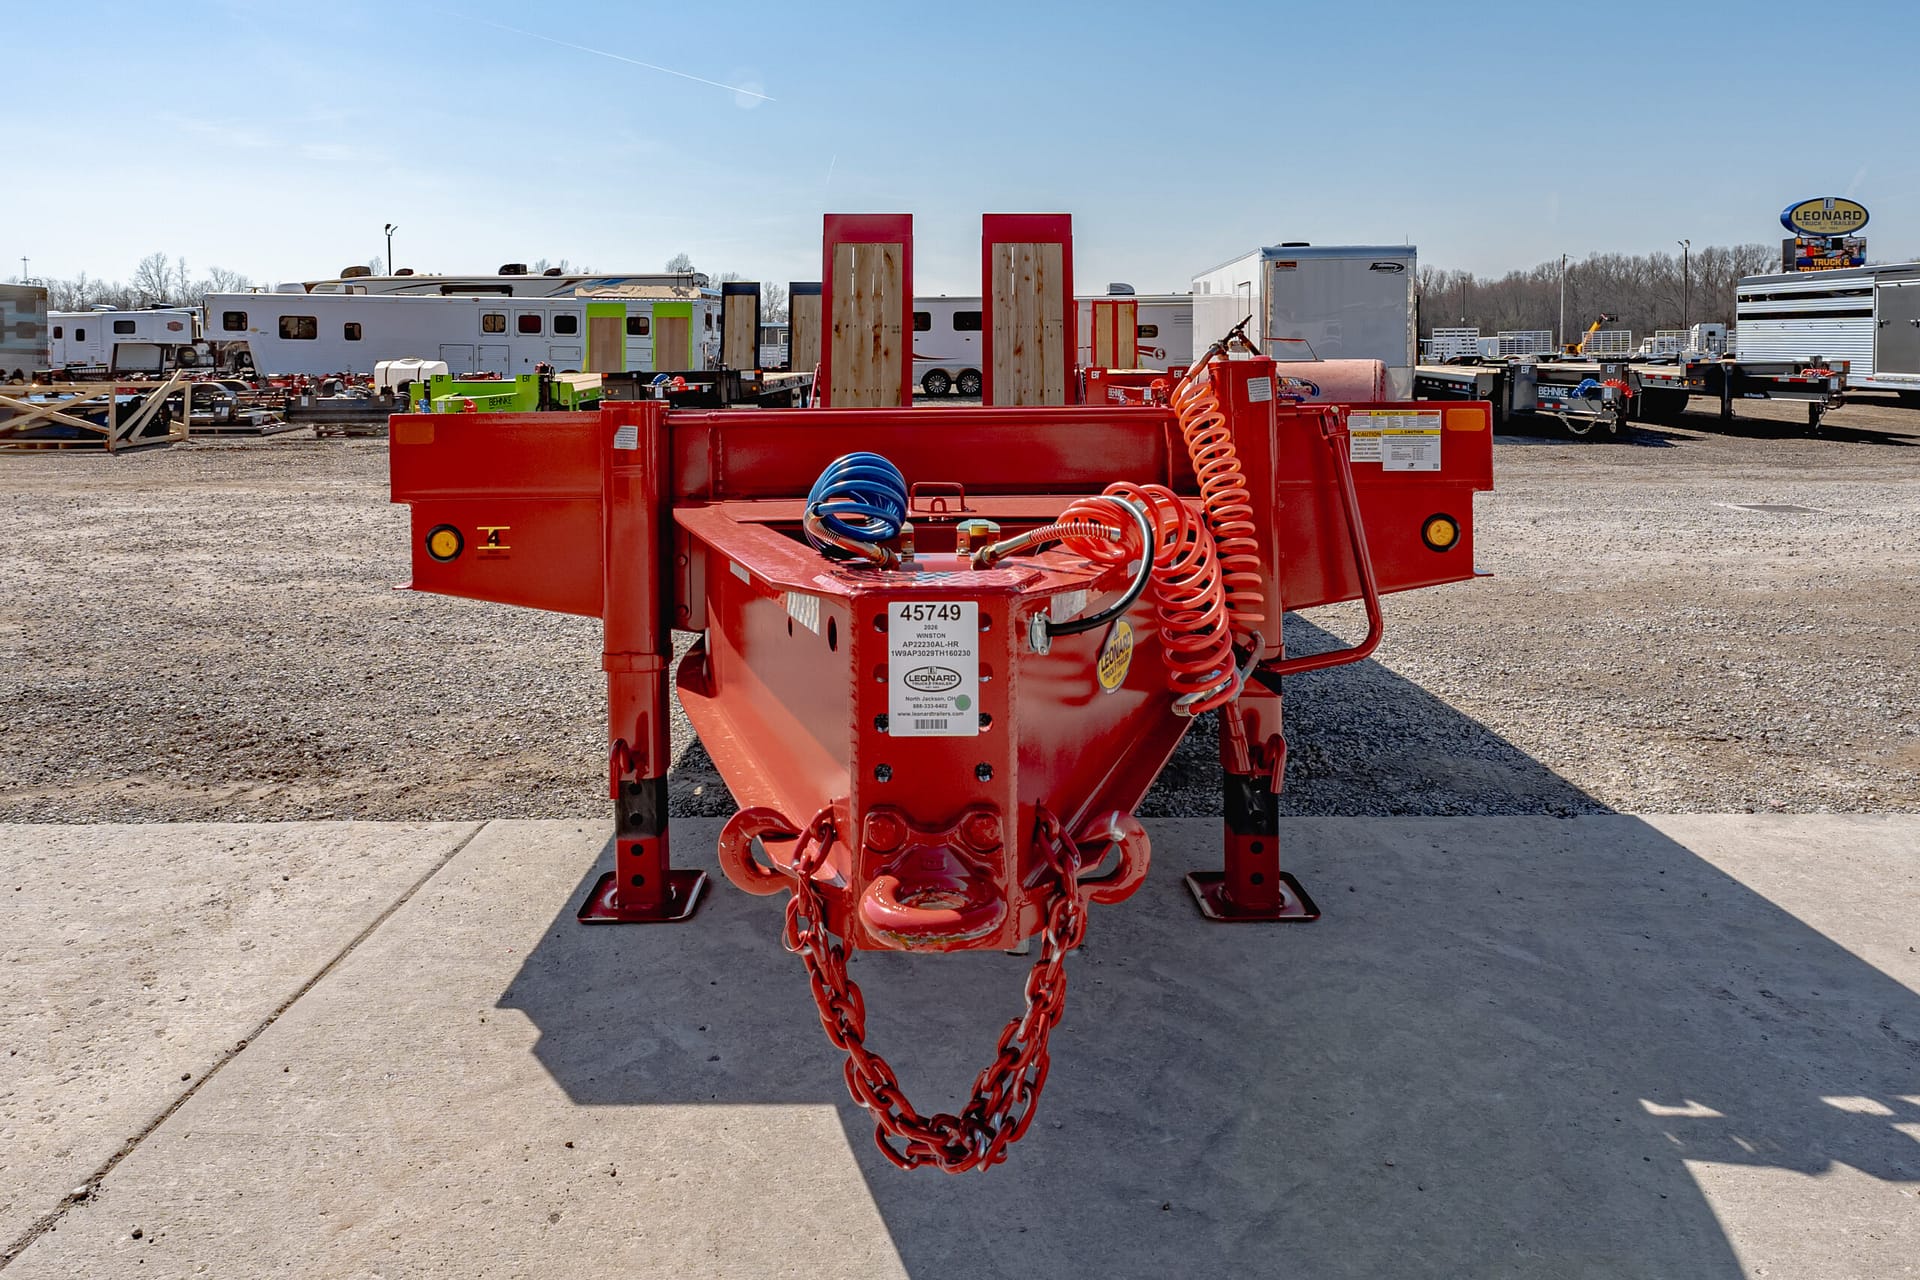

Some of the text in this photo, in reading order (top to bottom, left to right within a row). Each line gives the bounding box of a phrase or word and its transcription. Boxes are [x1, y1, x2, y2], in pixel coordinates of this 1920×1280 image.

[1795, 210, 1862, 221] LEONARD
[1812, 258, 1850, 266] TRUCK &
[1538, 386, 1569, 397] BEHNKE
[487, 529, 501, 547] 4
[900, 604, 962, 621] 45749
[1100, 631, 1131, 672] LEONARD
